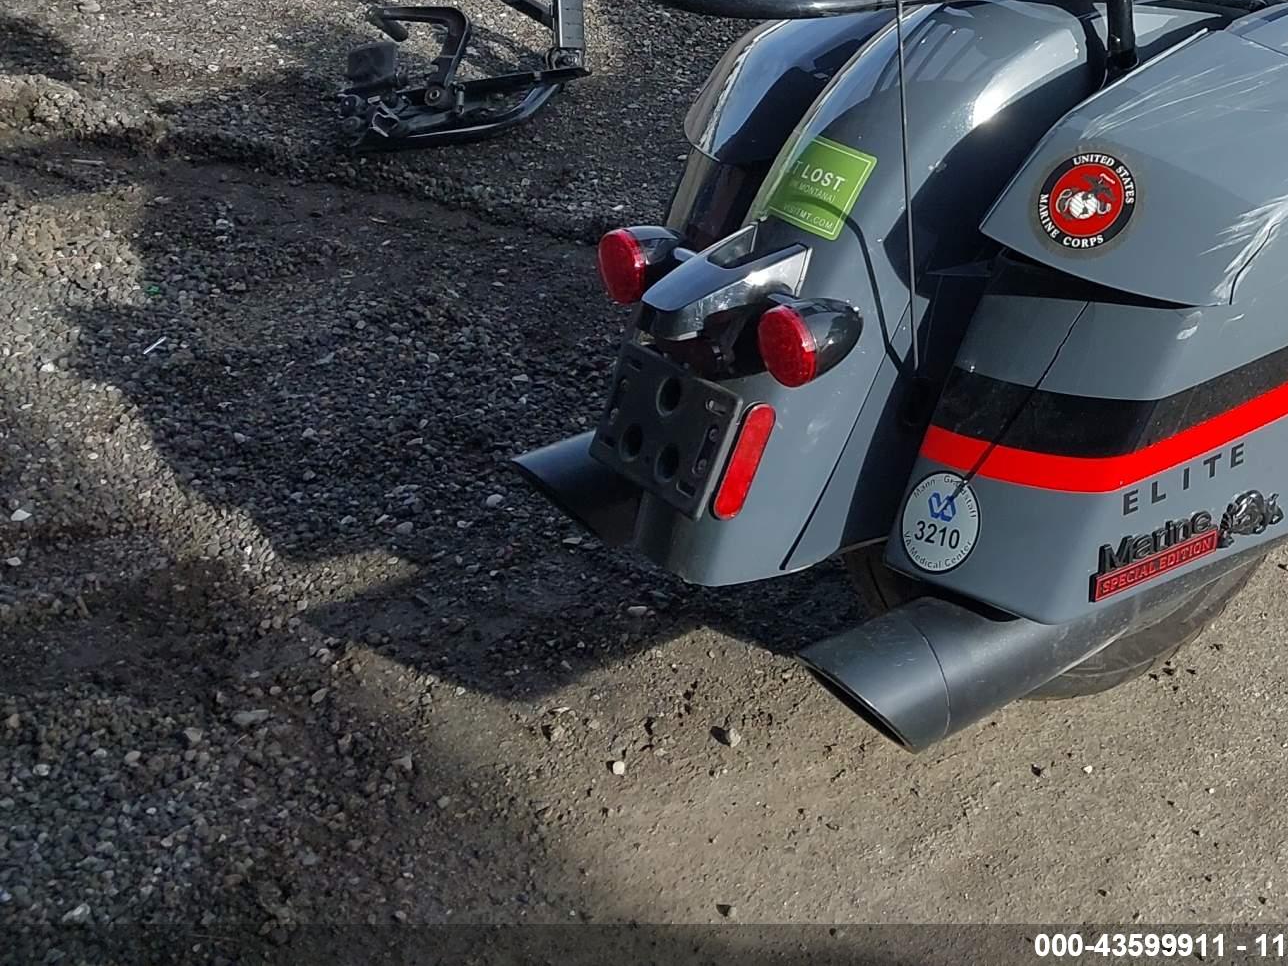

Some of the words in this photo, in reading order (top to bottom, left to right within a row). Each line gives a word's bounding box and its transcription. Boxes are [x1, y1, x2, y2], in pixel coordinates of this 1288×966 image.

[1073, 154, 1115, 167] UNITED
[1115, 165, 1135, 204] STATES
[1039, 193, 1060, 238] MARINE
[1063, 234, 1104, 248] CORPS
[1123, 442, 1245, 516] ELITE
[904, 530, 913, 546] VA
[909, 546, 942, 570] Medical
[944, 541, 973, 568] Center
[914, 520, 961, 549] 3210
[1098, 510, 1215, 574] Marine
[1101, 560, 1158, 595] SPECIAL
[1159, 536, 1213, 570] EDITION
